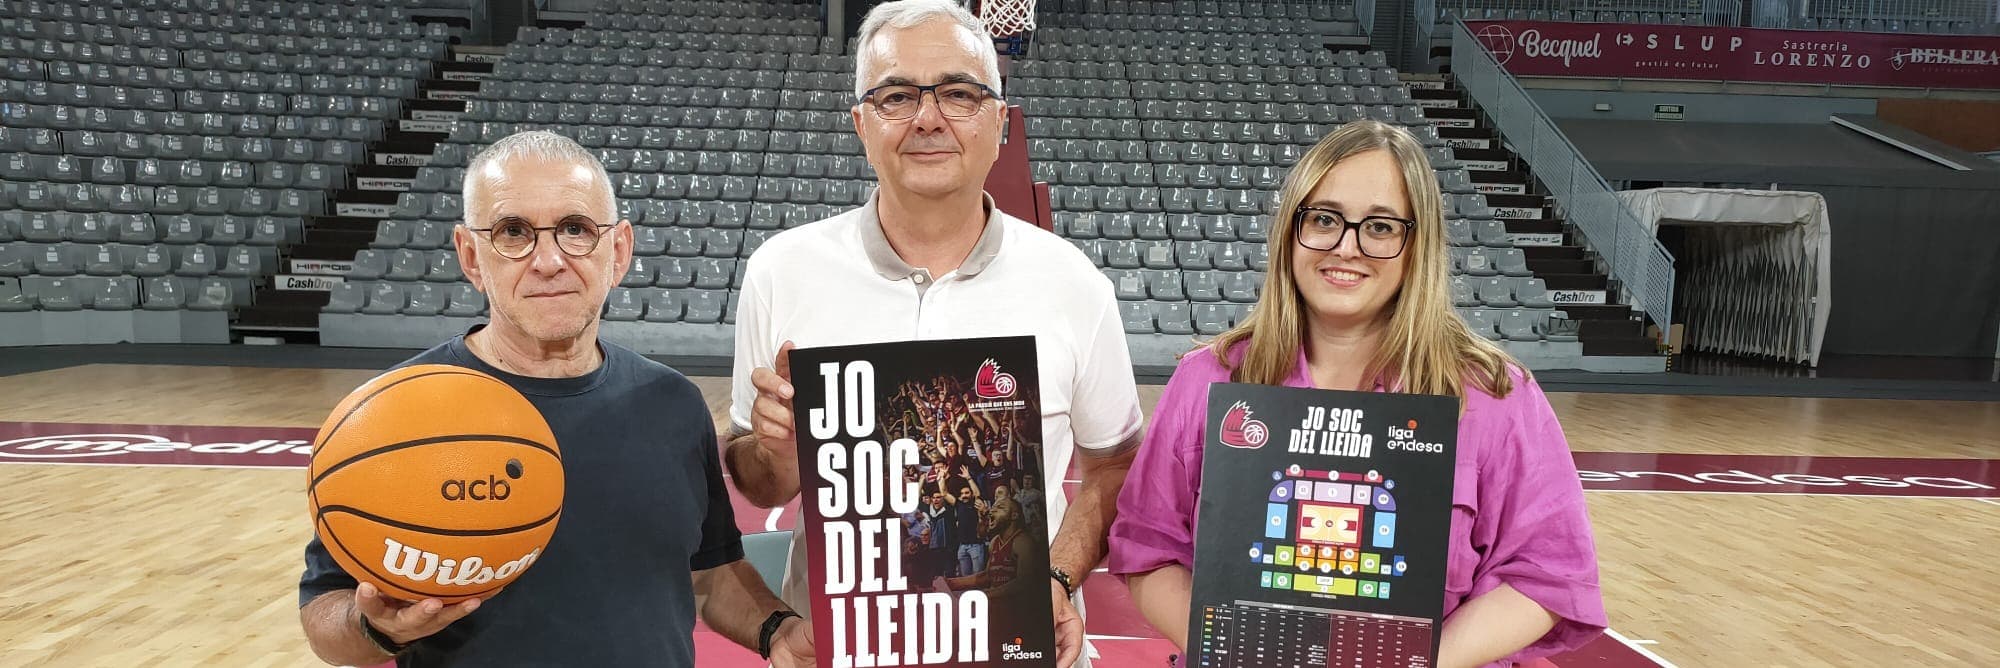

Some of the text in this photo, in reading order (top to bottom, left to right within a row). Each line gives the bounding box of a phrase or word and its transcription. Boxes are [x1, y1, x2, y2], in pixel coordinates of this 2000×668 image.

[1518, 29, 1602, 67] Becquel
[1783, 40, 1848, 51] Sastreria
[1754, 52, 1871, 69] LORENZO
[386, 155, 424, 165] CashDro
[1494, 209, 1532, 218] CashDro
[287, 277, 333, 289] CashDro
[1553, 291, 1595, 302] CashDro
[809, 359, 875, 439] JO
[1302, 406, 1363, 433] JO SOC
[1388, 425, 1413, 440] liga
[1288, 428, 1373, 458] DEL LLEIDA
[1387, 439, 1443, 453] endesa
[818, 438, 920, 518] SOC
[441, 475, 511, 501] acb
[382, 537, 542, 586] Wilson
[823, 517, 908, 595] DEL
[830, 589, 989, 668] LLEIDA
[1002, 643, 1020, 652] liga
[1003, 651, 1042, 660] endesa
